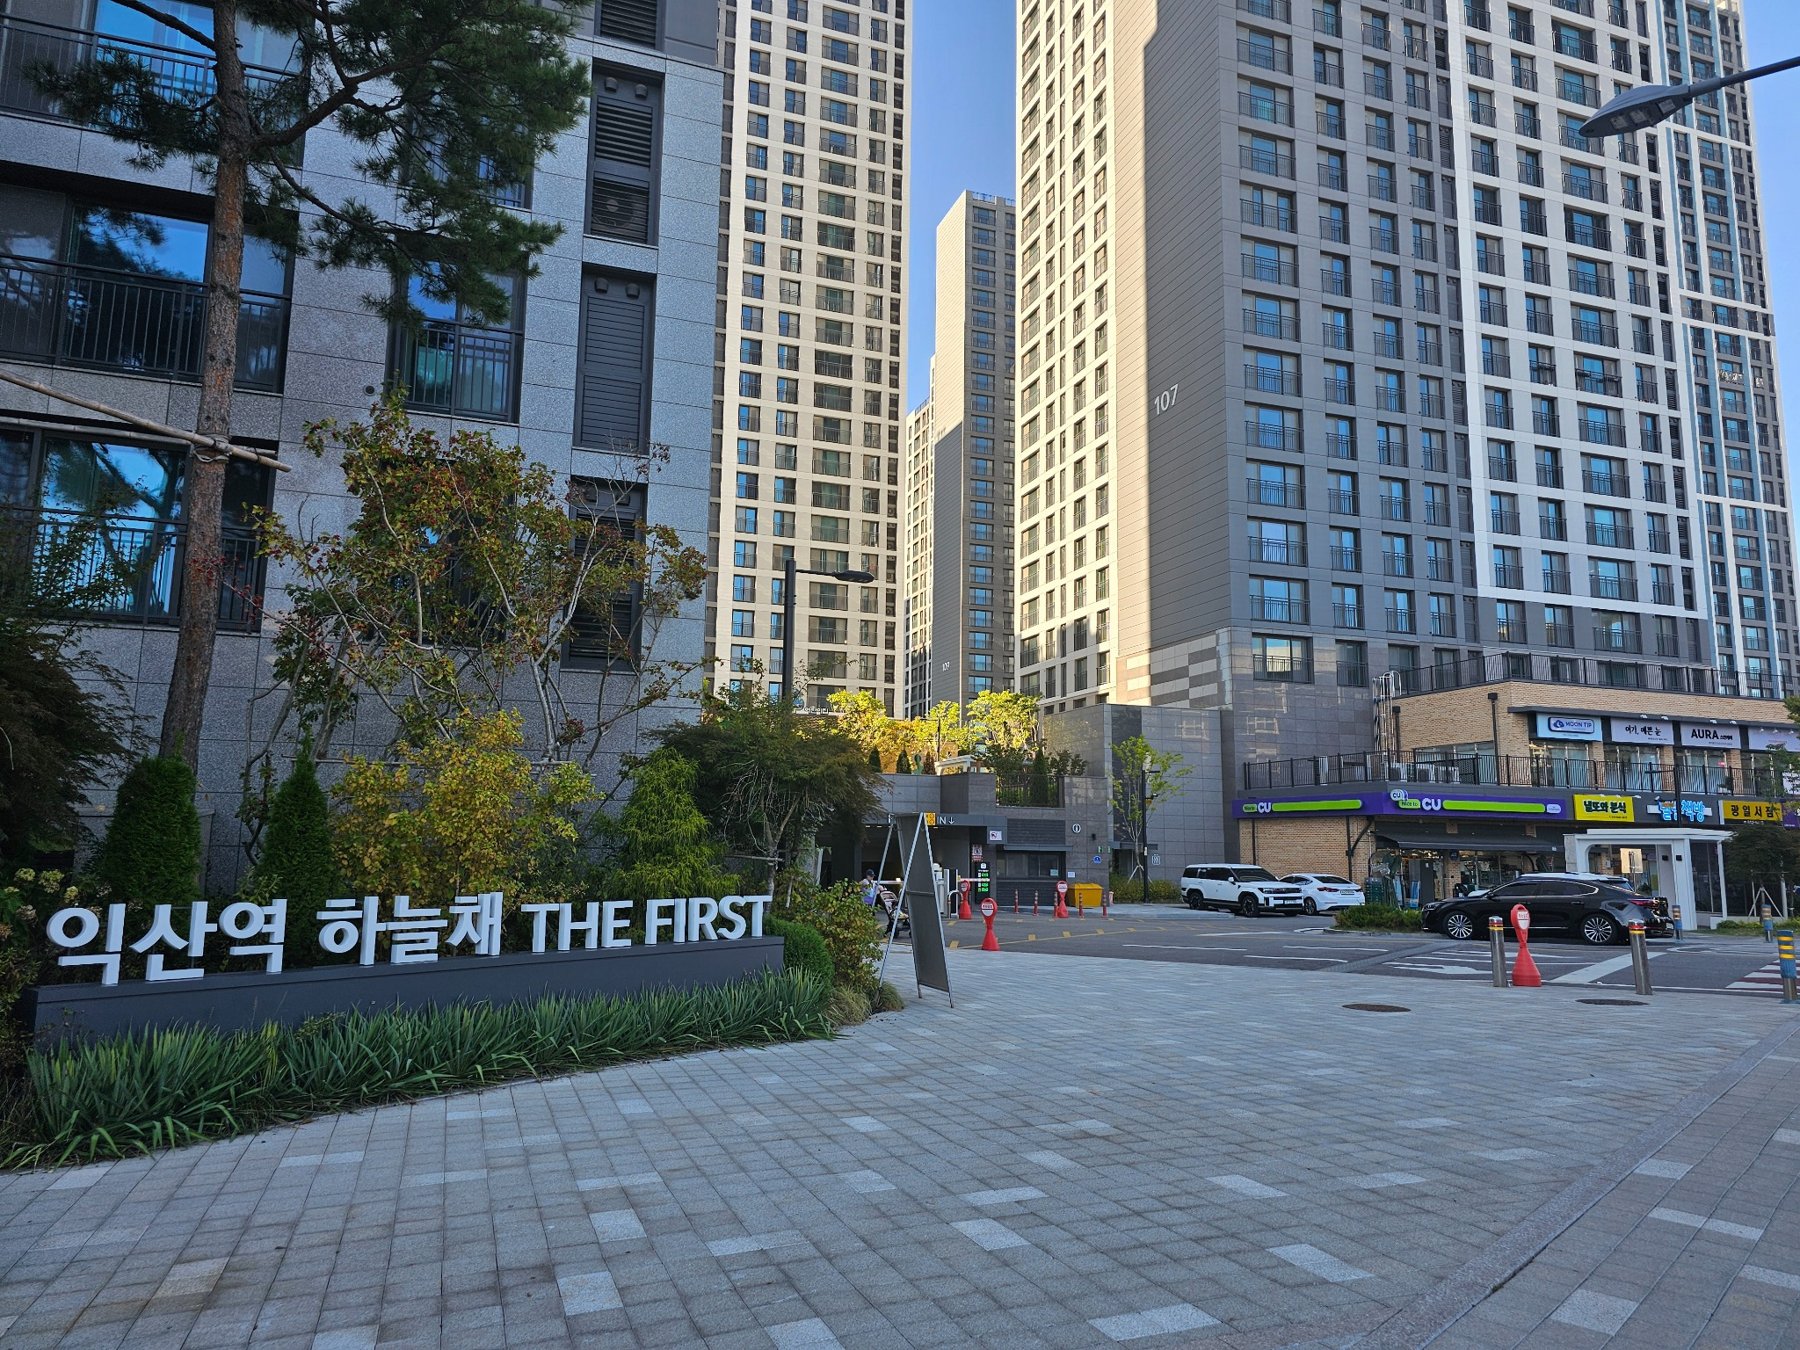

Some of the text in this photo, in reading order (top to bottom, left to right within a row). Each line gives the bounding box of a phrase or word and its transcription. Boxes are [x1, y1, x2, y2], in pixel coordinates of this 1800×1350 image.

[1154, 383, 1179, 415] 107
[1565, 720, 1582, 728] MOON
[1691, 728, 1719, 740] AURA
[1257, 802, 1272, 813] CU
[1422, 798, 1441, 811] CU
[46, 892, 773, 986] 익산역 하늘채 THE FIRST
